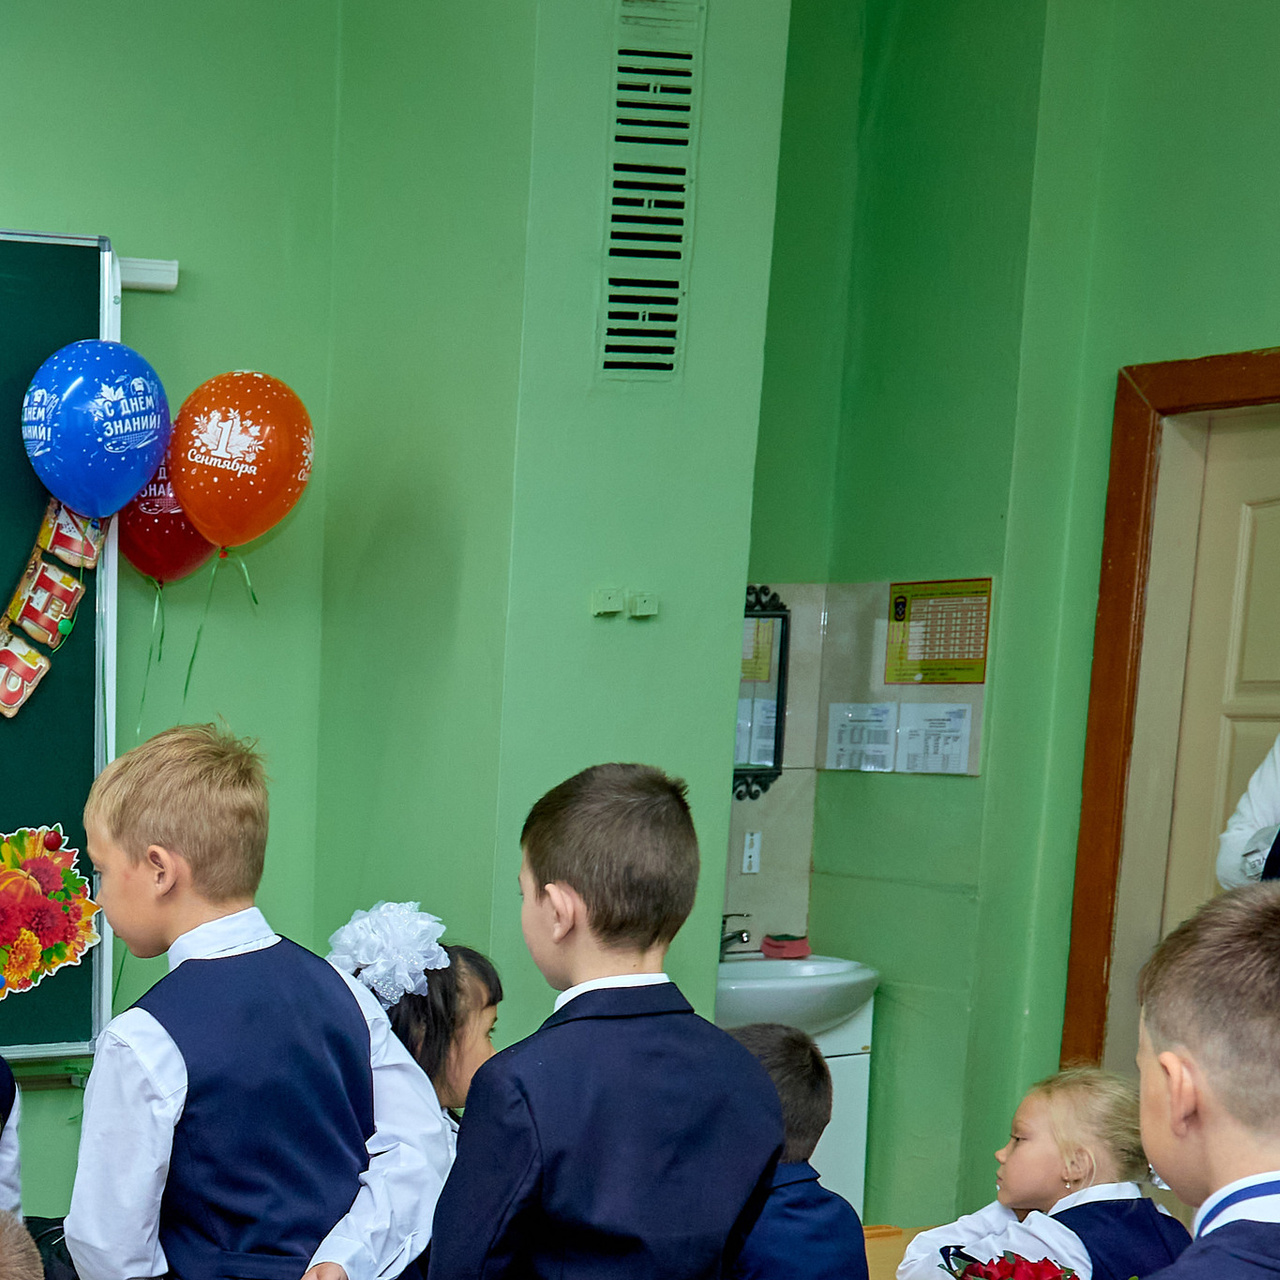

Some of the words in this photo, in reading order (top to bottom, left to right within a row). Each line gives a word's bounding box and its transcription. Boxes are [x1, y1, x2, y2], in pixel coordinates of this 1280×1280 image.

[104, 400, 115, 417] С
[103, 411, 161, 437] ЗНАНИЙ!
[211, 419, 234, 459] 1
[187, 448, 258, 478] Сентября
